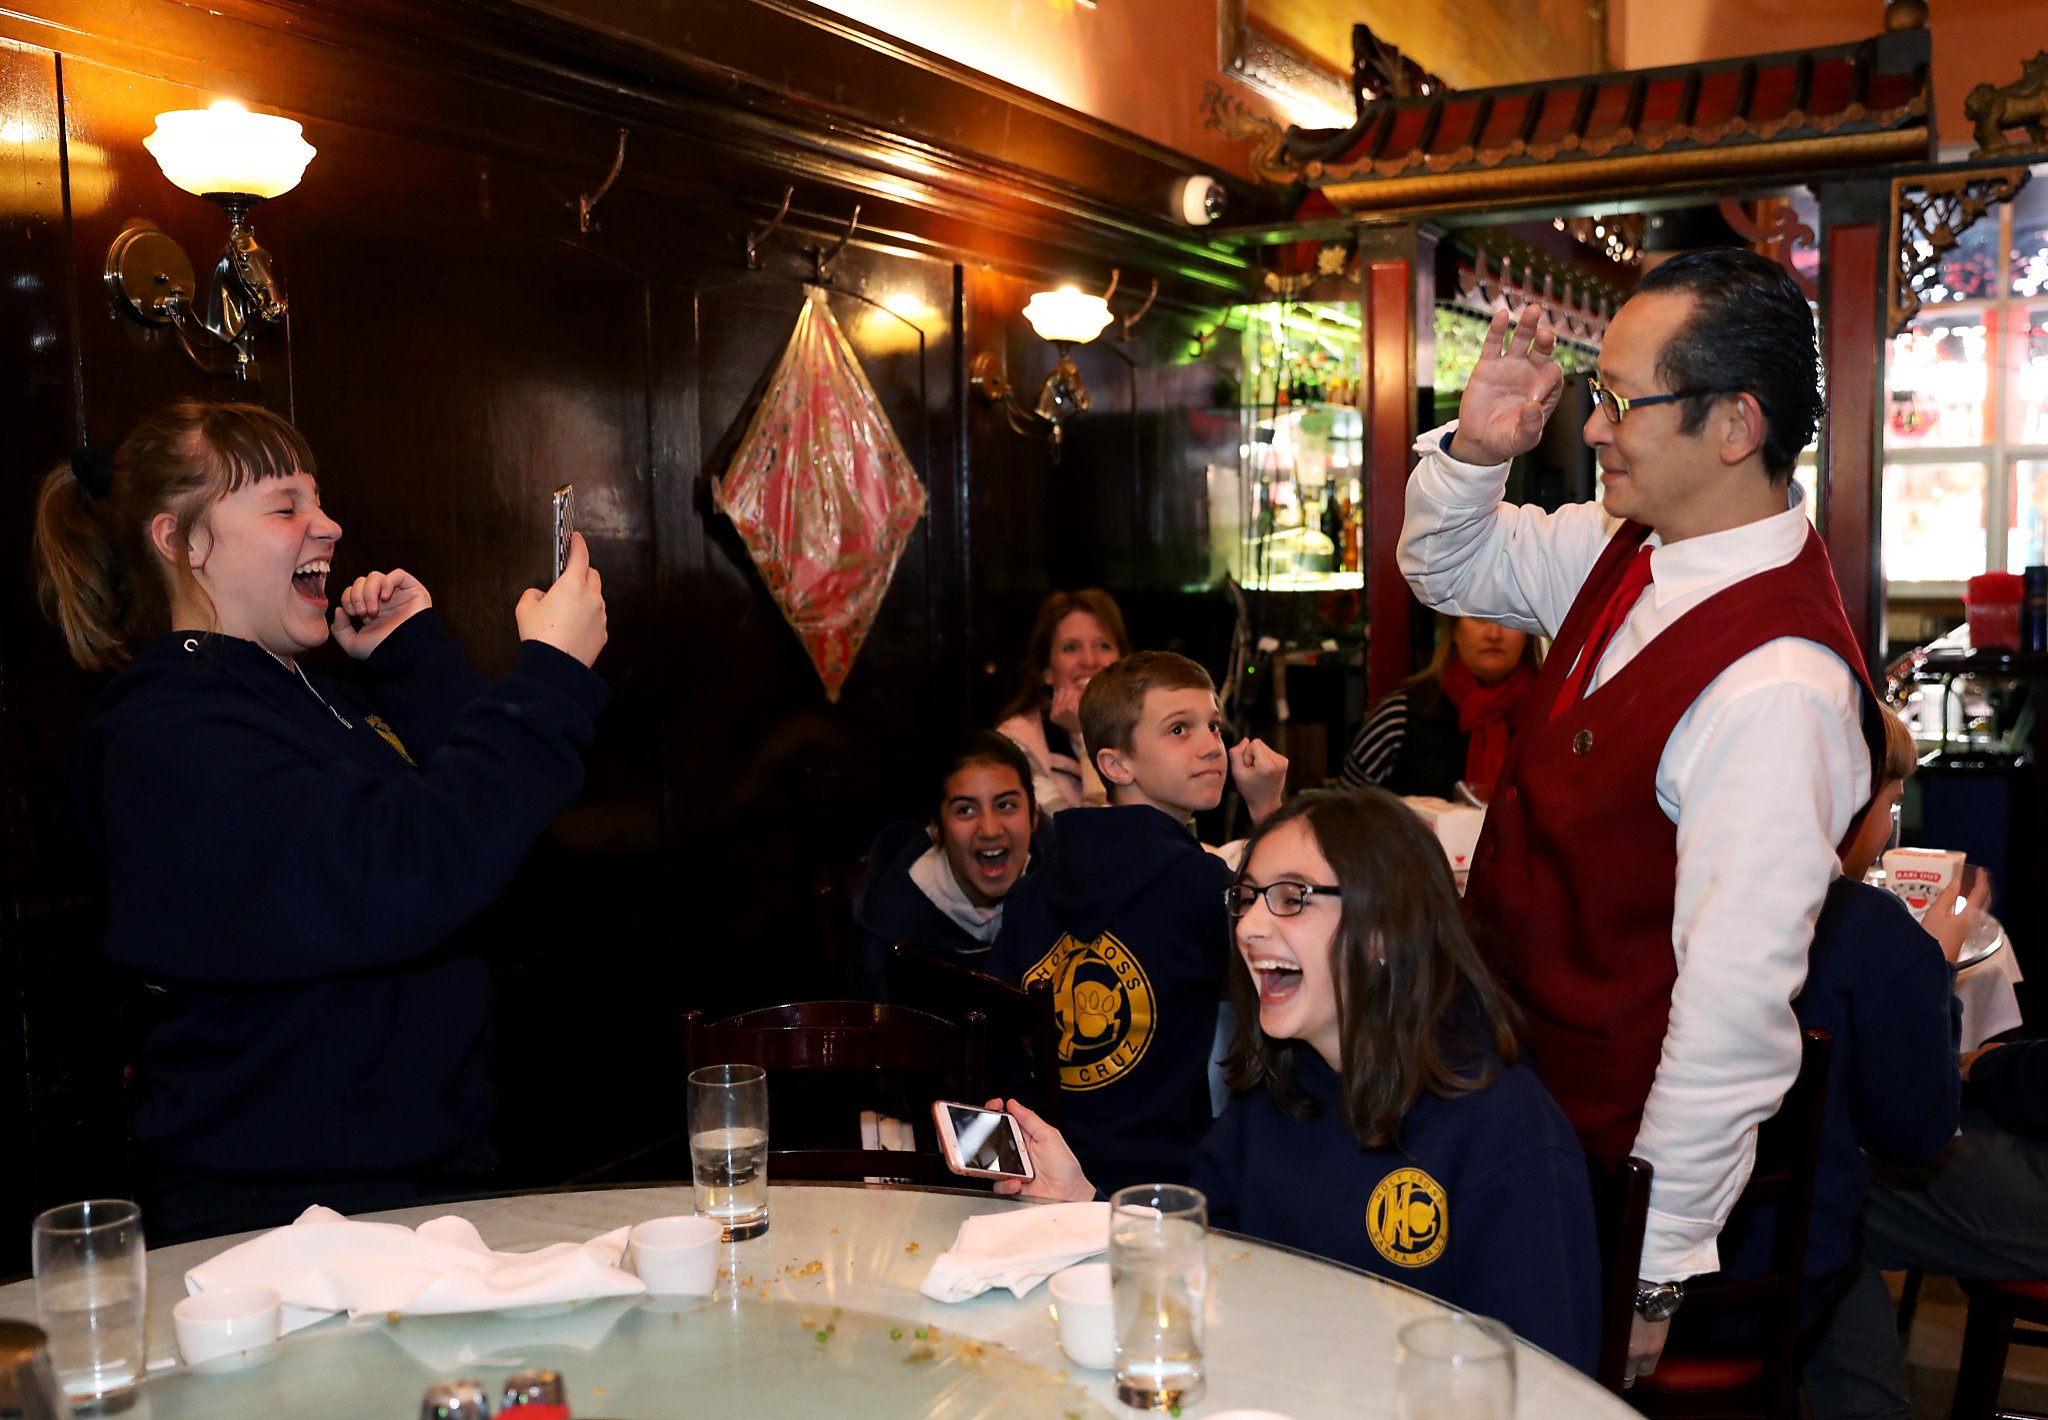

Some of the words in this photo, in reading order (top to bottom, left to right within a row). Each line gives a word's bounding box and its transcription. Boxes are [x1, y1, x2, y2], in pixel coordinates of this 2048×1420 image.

[1094, 936, 1141, 991] ROSS
[1079, 1040, 1139, 1082] CRUZ
[1375, 1174, 1402, 1201] HOLY
[1410, 1173, 1444, 1204] CROSS
[1373, 1231, 1408, 1262] SANTA
[1416, 1234, 1444, 1262] CRUZ
